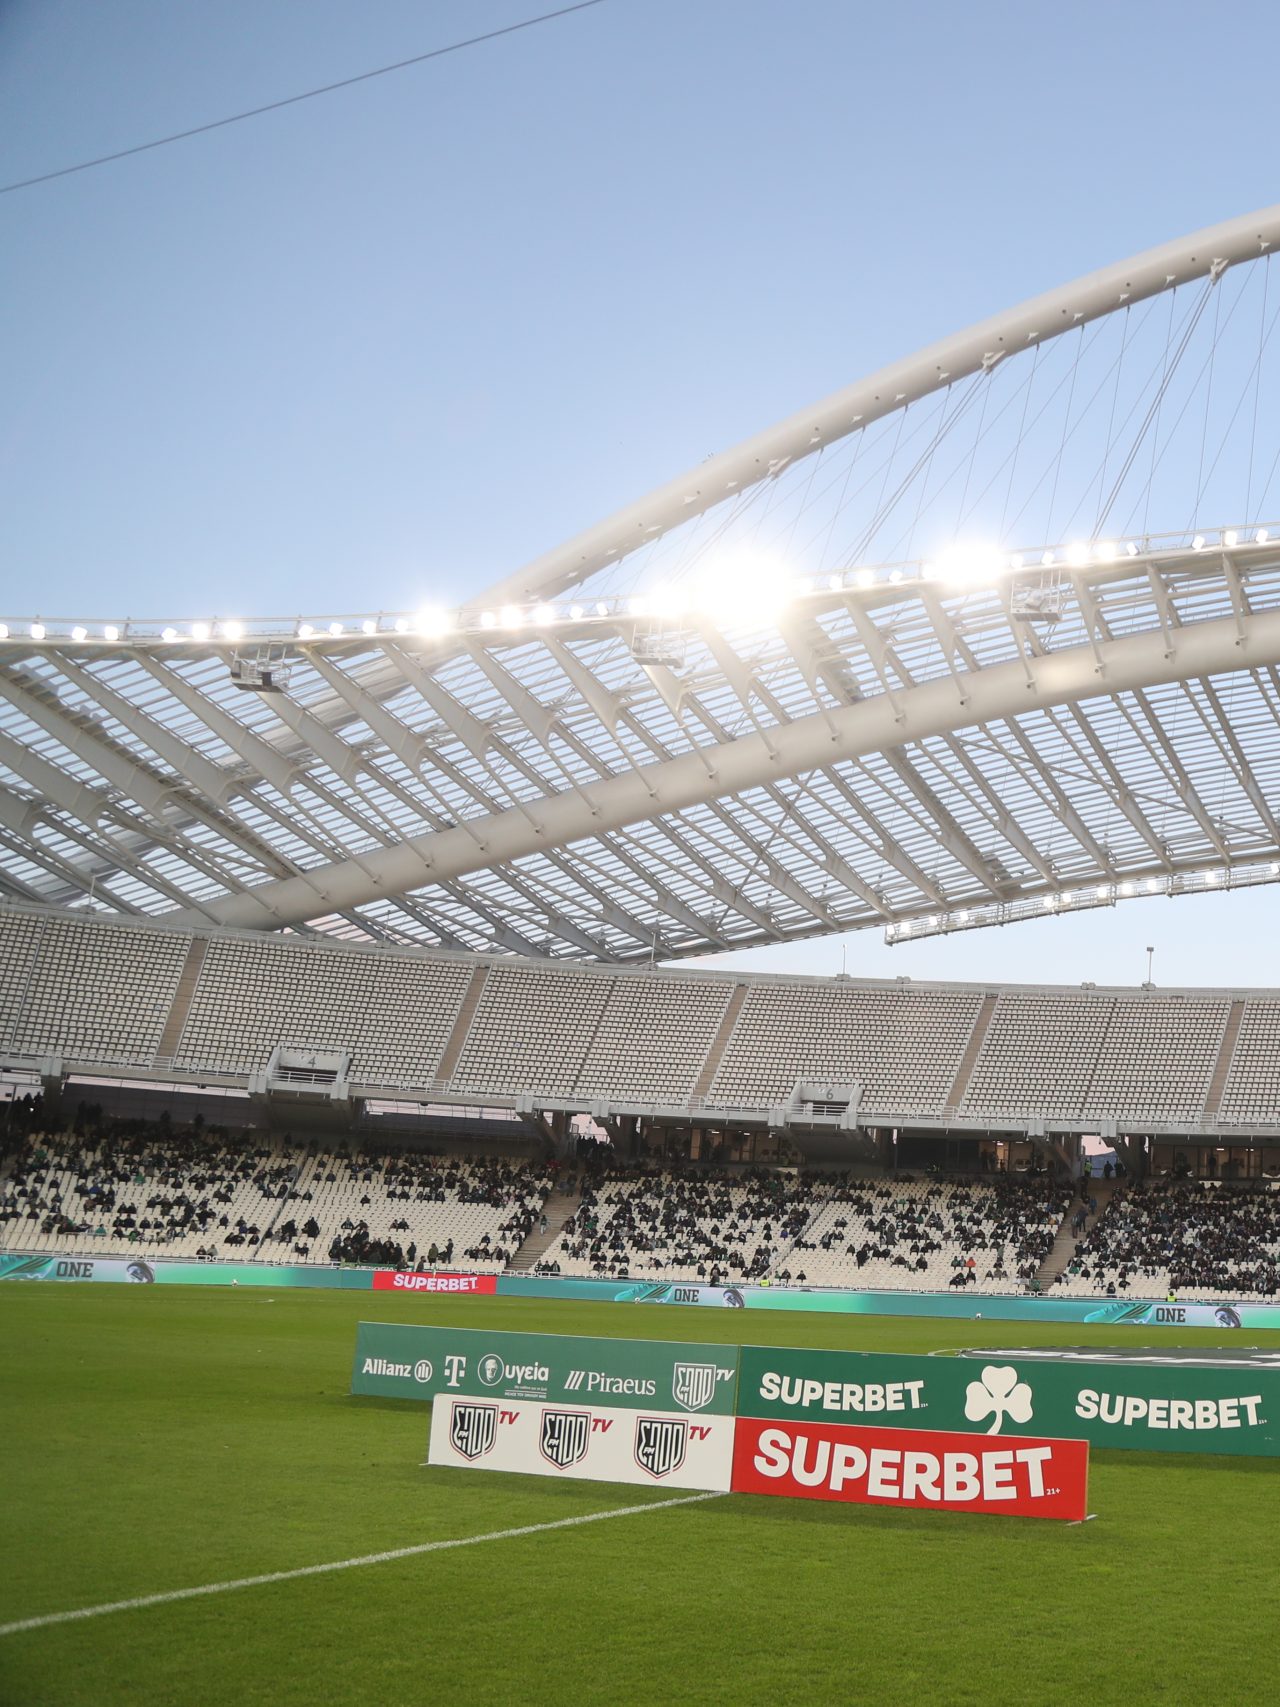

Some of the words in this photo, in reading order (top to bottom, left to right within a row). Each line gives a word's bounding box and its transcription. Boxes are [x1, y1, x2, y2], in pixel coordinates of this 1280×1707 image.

[826, 1088, 834, 1100] 6
[56, 1261, 93, 1278] ONE
[393, 1273, 478, 1290] SUPERBET
[674, 1288, 699, 1302] ONE
[1156, 1308, 1186, 1323] ONE
[362, 1358, 412, 1378] Allianz
[716, 1369, 735, 1381] TV
[586, 1371, 656, 1396] Piraeus
[760, 1372, 924, 1412] SUPERBET
[1075, 1388, 1262, 1430] SUPERBET
[500, 1411, 520, 1424] TV
[592, 1418, 614, 1432] TV
[690, 1426, 712, 1440] TV
[753, 1428, 1052, 1502] SUPERBET
[1046, 1488, 1060, 1496] 21+
